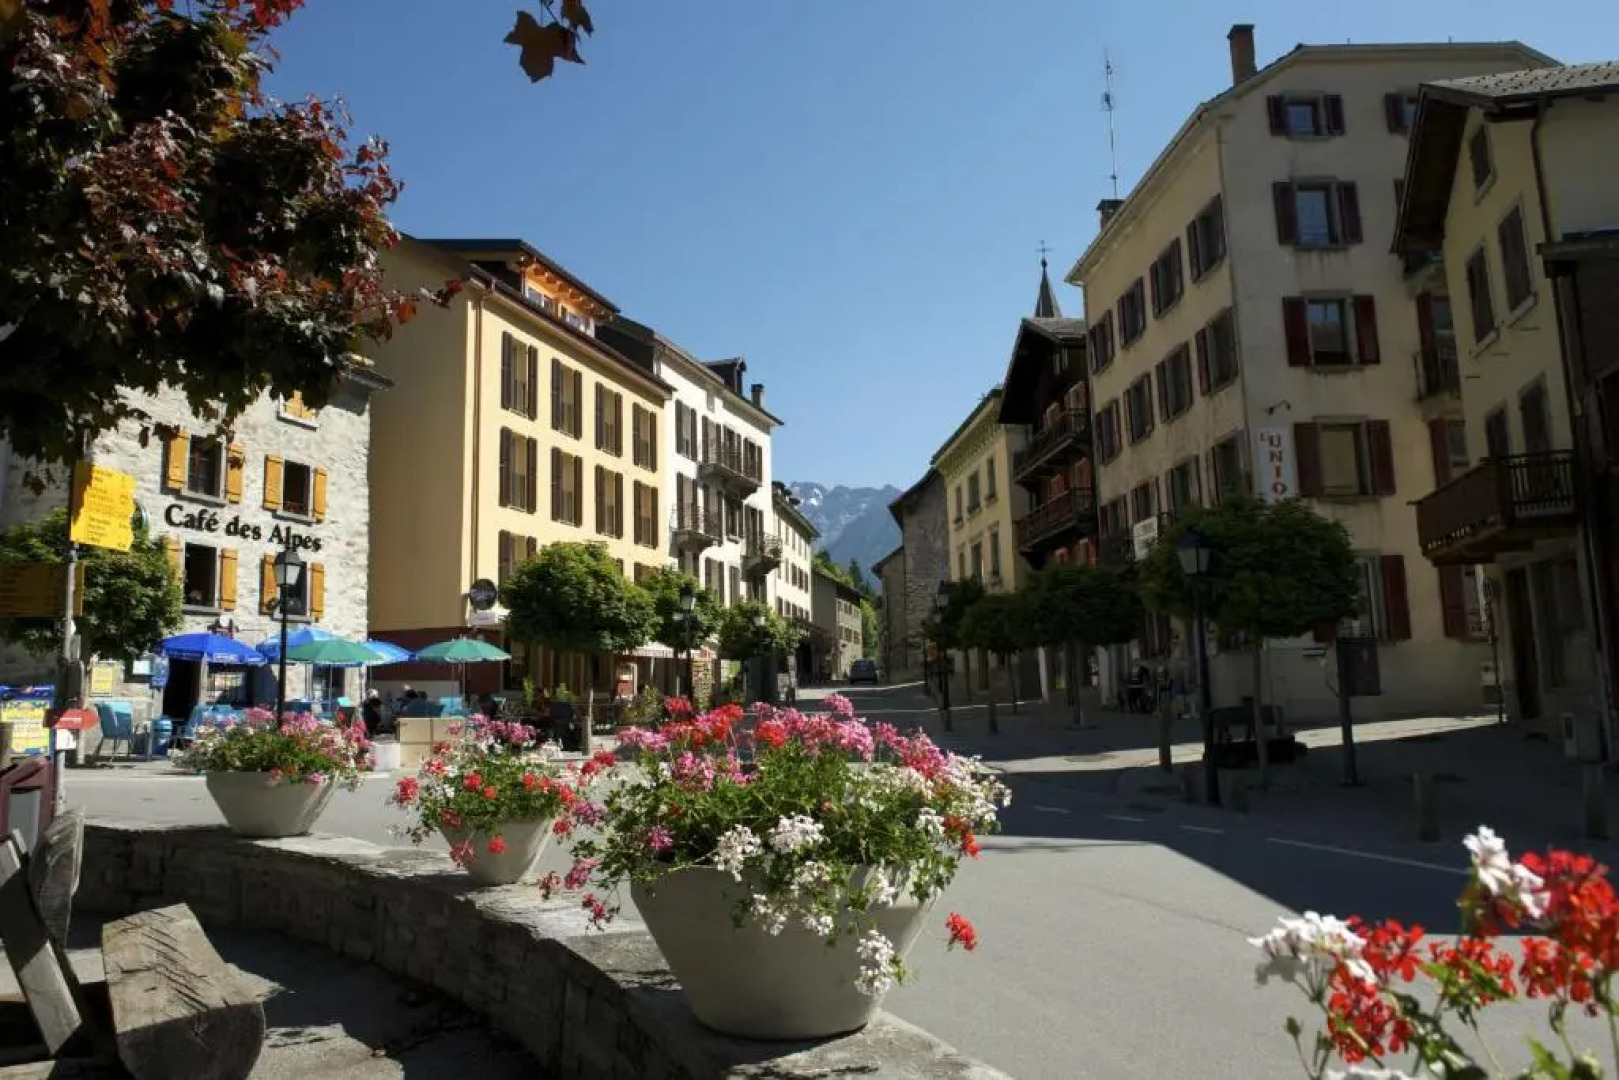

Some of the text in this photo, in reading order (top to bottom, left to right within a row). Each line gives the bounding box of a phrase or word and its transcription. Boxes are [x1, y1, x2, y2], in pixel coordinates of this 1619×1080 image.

[164, 503, 323, 553] Café des Alpes
